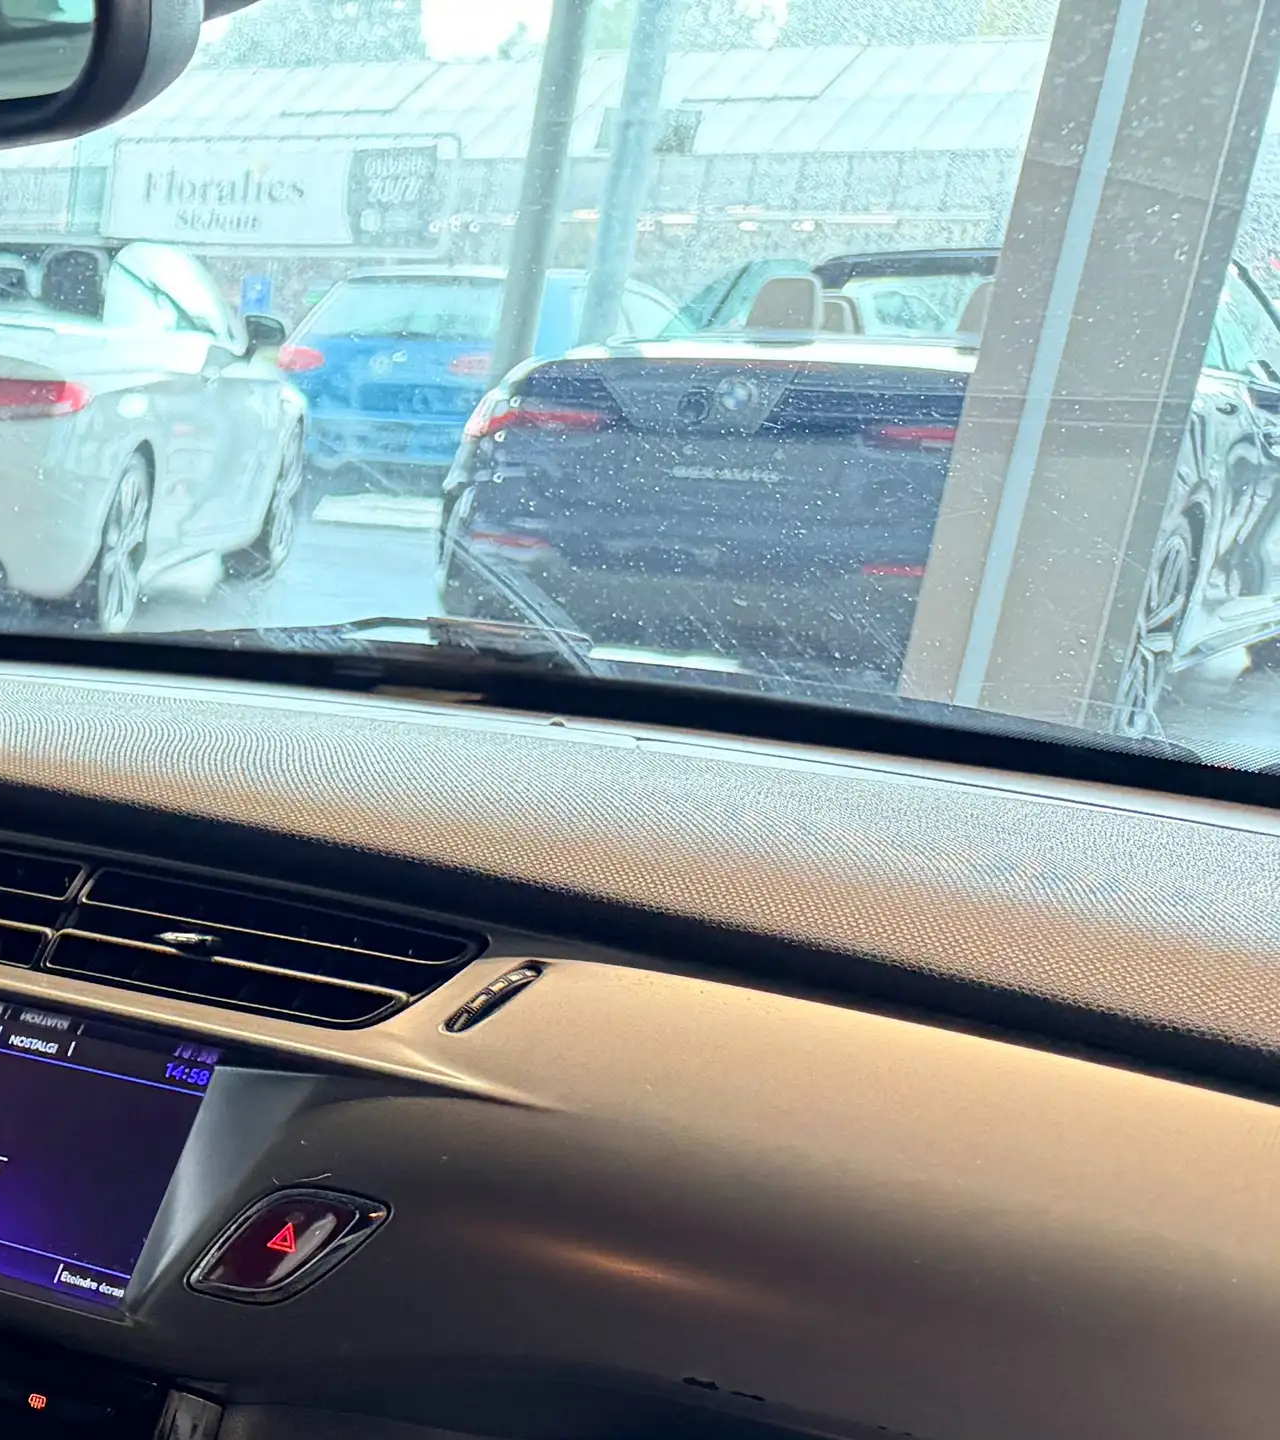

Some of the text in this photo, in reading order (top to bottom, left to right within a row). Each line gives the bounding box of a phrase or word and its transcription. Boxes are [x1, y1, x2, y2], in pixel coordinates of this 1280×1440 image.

[7, 1034, 60, 1055] NOSTALGI
[165, 1062, 211, 1086] 14:58
[98, 1282, 125, 1298] écran
